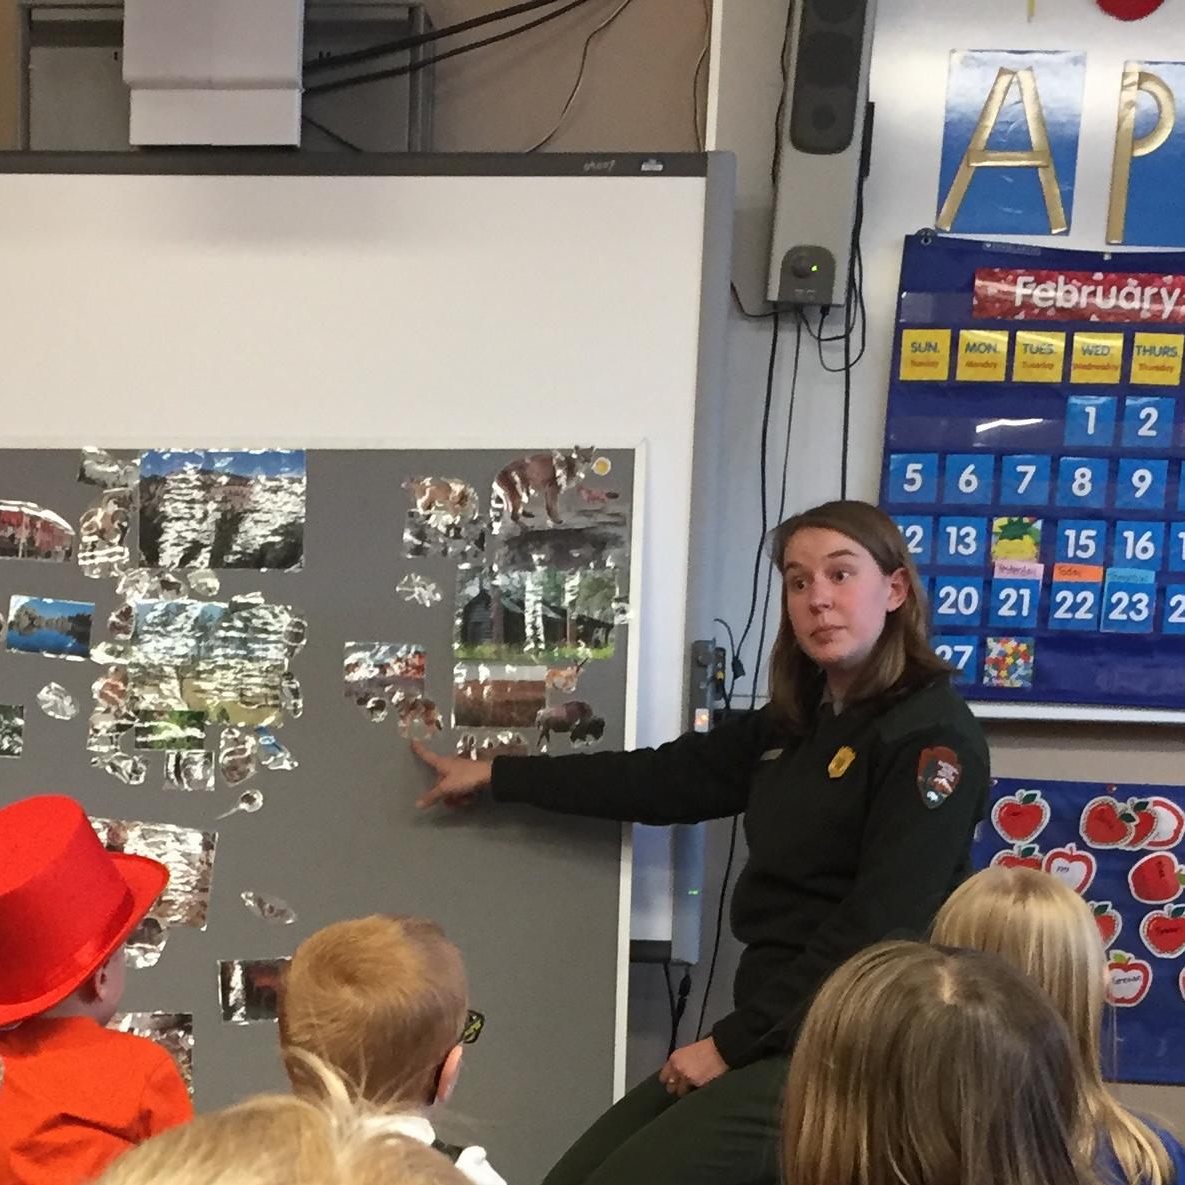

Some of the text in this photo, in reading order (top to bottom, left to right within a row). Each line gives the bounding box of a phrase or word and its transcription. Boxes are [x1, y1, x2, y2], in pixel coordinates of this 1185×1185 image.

[935, 66, 1068, 234] A
[1015, 275, 1182, 320] February
[1084, 406, 1096, 435] 1
[1138, 407, 1159, 436] 2
[903, 463, 923, 492] 5
[958, 464, 979, 493] 6
[1016, 465, 1037, 494] 7
[1071, 467, 1092, 497] 8
[1131, 468, 1152, 498] 9
[946, 526, 977, 555] 13
[1065, 529, 1097, 558] 15
[1123, 530, 1155, 560] 16
[937, 585, 979, 615] 20
[998, 587, 1031, 617] 21
[1054, 590, 1094, 620] 22
[1108, 591, 1150, 621] 23
[1168, 594, 1185, 623] 2
